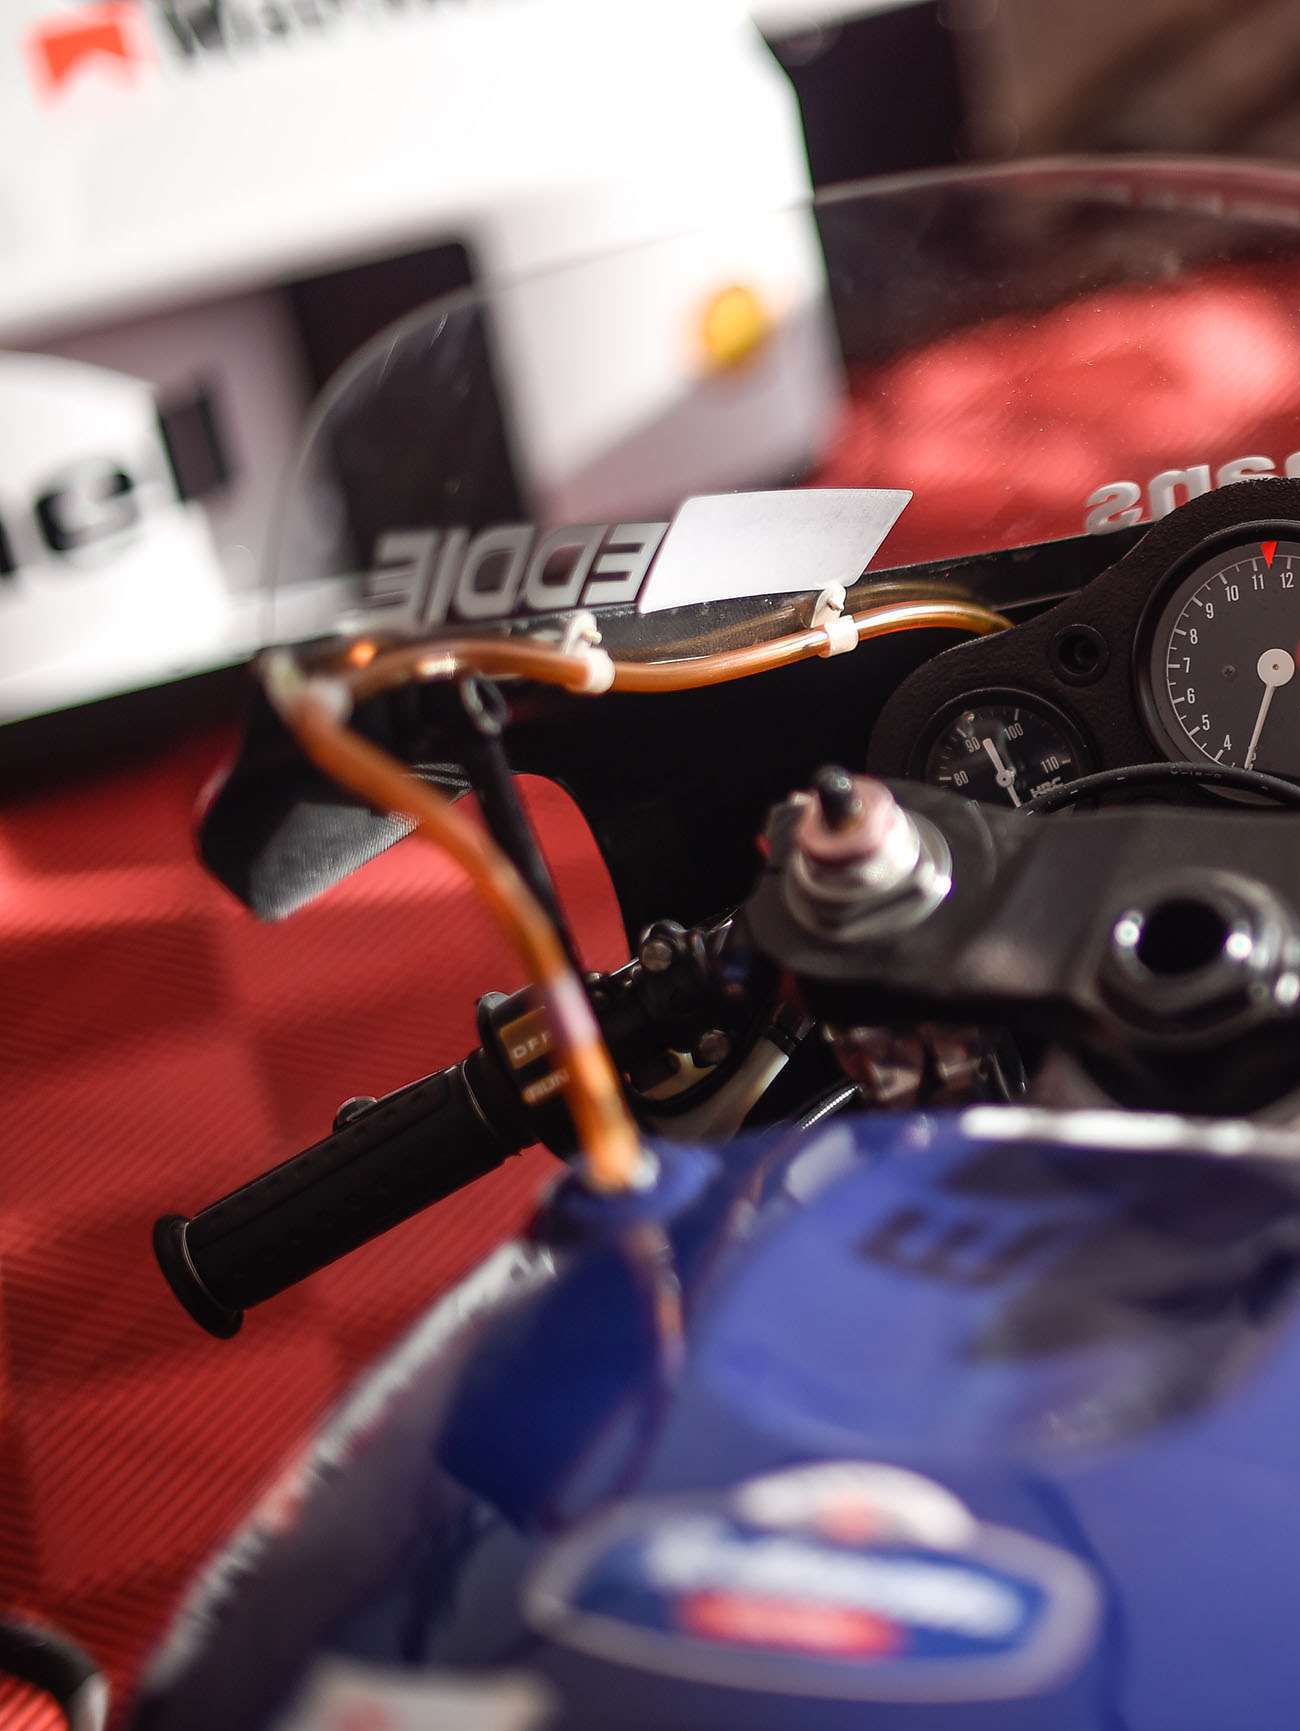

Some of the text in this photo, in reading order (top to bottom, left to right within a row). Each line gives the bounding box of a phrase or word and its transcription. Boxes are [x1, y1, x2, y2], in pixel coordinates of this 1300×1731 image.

[1251, 574, 1265, 590] 11
[1280, 573, 1295, 589] 12
[1225, 585, 1239, 602] 10
[1205, 603, 1214, 619] 9
[1190, 629, 1198, 645] 8
[1183, 658, 1192, 673] 7
[1187, 688, 1195, 704] 6
[1202, 714, 1210, 731] 5
[1003, 722, 1024, 742] 100
[965, 737, 981, 753] 90
[1223, 734, 1232, 751] 4
[1041, 756, 1060, 774] 110
[953, 770, 969, 787] 80
